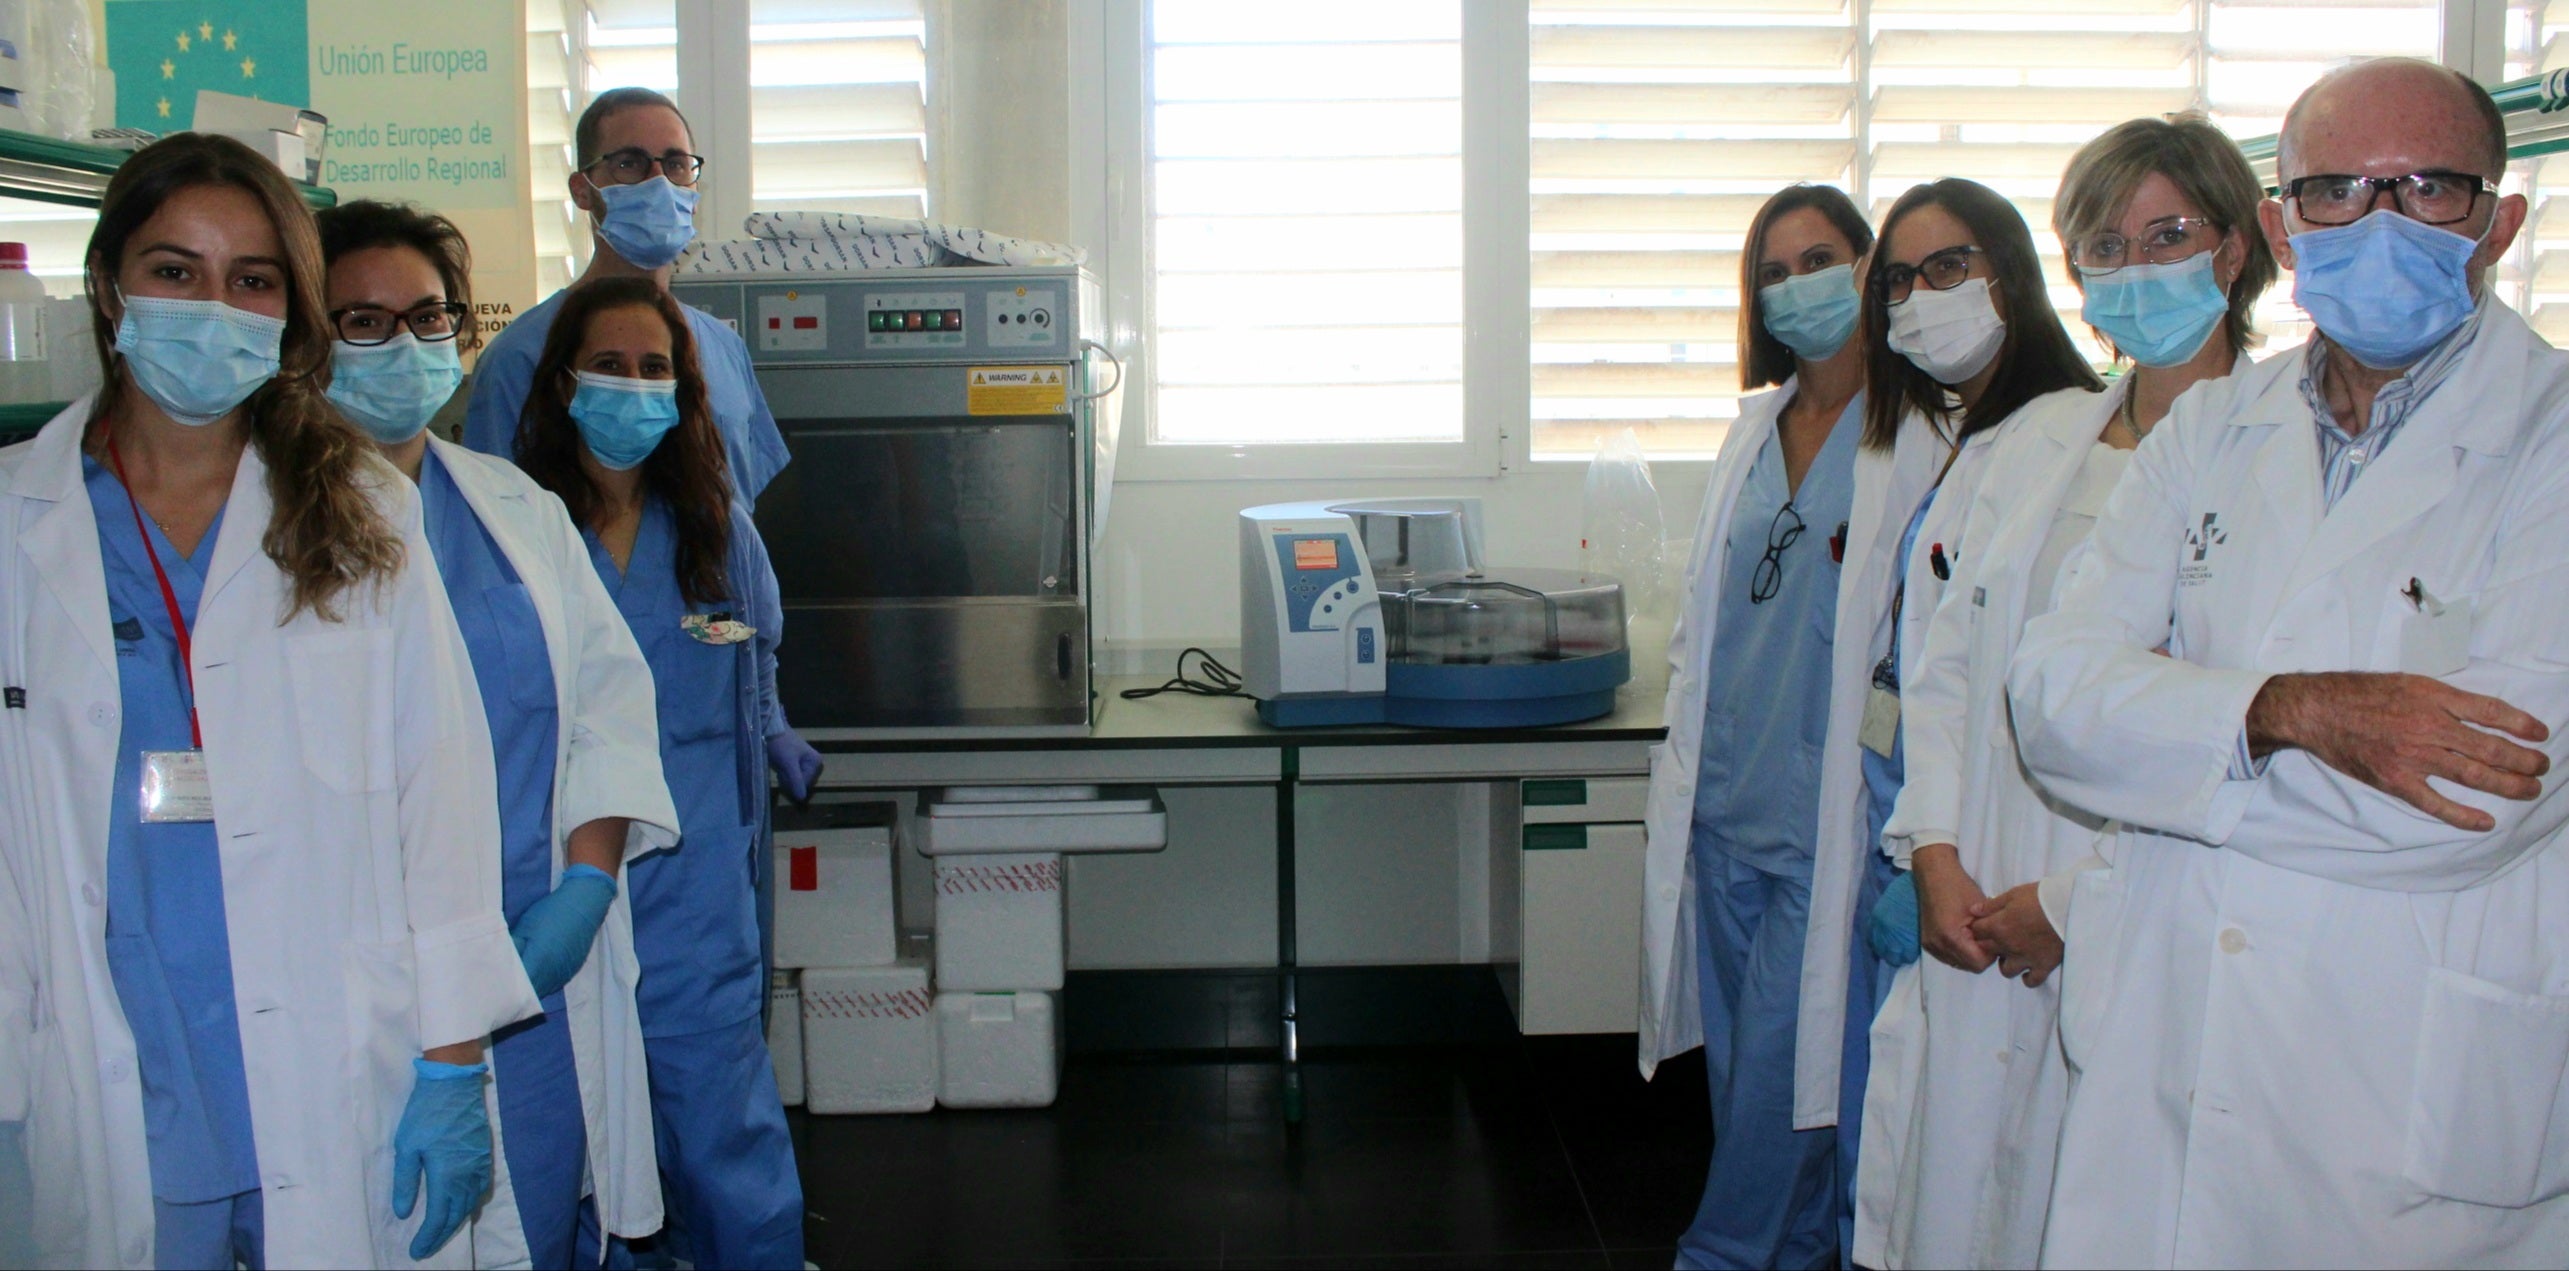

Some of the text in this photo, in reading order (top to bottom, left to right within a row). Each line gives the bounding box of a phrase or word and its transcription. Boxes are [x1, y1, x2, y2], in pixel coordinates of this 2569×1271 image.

[318, 42, 489, 81] Unión Europea
[325, 119, 493, 150] Fondo Europeo de
[326, 153, 507, 185] Desarrollo Regional
[988, 373, 1028, 382] WARNING
